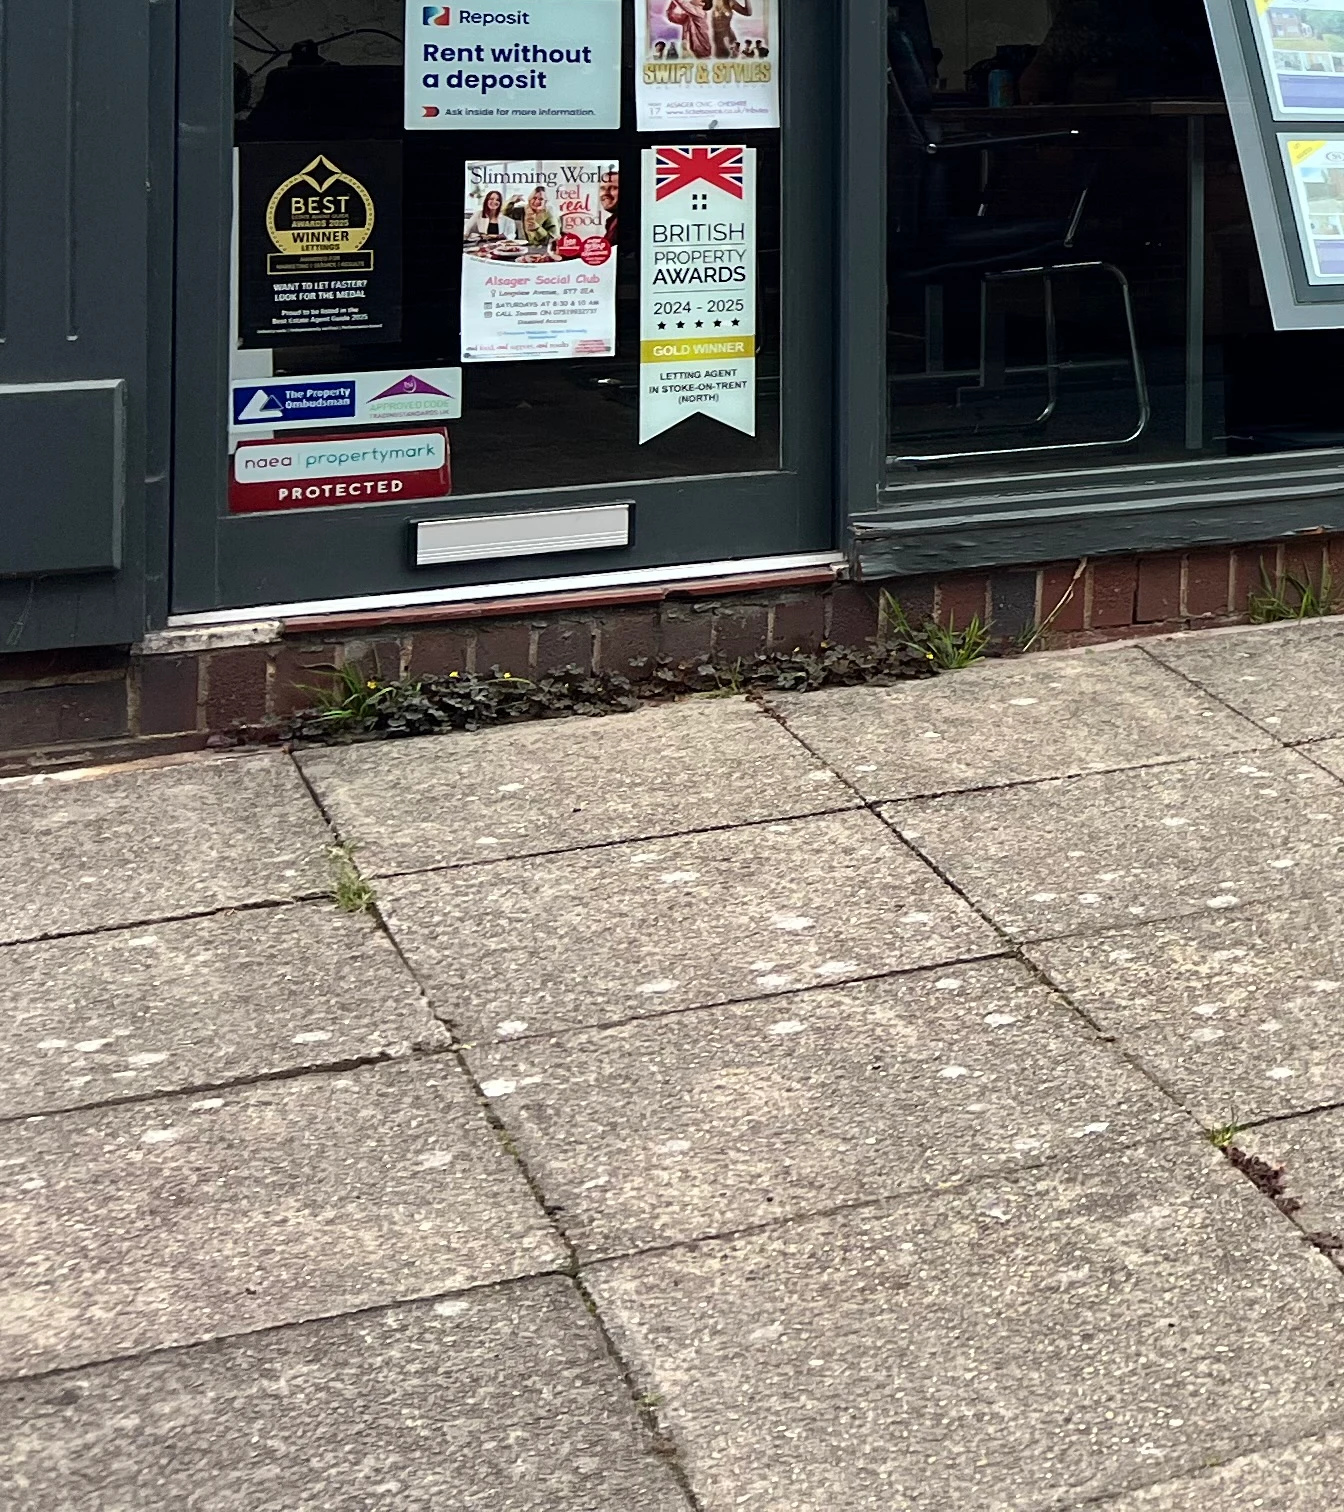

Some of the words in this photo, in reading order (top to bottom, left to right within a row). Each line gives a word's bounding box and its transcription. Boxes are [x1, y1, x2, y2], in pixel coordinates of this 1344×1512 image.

[459, 9, 530, 27] Reposit
[423, 43, 487, 63] Rent
[490, 42, 592, 65] without
[643, 62, 694, 85] SWIFT
[696, 62, 709, 84] &
[712, 62, 772, 85] STYLES
[422, 73, 440, 90] a
[446, 69, 547, 95] deposit
[444, 108, 463, 116] Ask
[465, 107, 494, 116] inside
[496, 107, 509, 116] for
[470, 165, 558, 187] Slimming
[560, 165, 613, 184] World
[555, 184, 580, 200] feel
[291, 196, 350, 214] BEST
[559, 194, 591, 212] real
[565, 210, 602, 229] good
[292, 230, 350, 243] WINNER
[653, 222, 745, 244] BRITISH
[654, 248, 747, 266] PROPERTY
[485, 276, 530, 288] Alsager
[535, 275, 570, 285] Social
[576, 274, 601, 284] Club
[652, 265, 747, 286] AWARDS
[273, 282, 299, 291] WANT
[301, 282, 313, 290] TO
[314, 281, 329, 290] LET
[331, 280, 368, 288] FASTER?
[274, 293, 297, 301] LOOK
[299, 292, 316, 300] FOR
[318, 291, 335, 299] THE
[336, 290, 366, 298] MEDAL
[653, 301, 692, 315] 2024
[707, 299, 744, 313] 2025
[653, 344, 691, 357] GOLD
[693, 342, 745, 355] WINNER
[660, 370, 702, 381] LETTING
[704, 368, 737, 378] AGENT
[285, 390, 304, 399] The
[306, 388, 351, 399] Property
[649, 385, 659, 394] IN
[661, 381, 747, 393] STOKE-ON-TRENT
[285, 398, 351, 409] Ombudsman
[369, 401, 421, 412] APPROVED
[423, 399, 450, 409] CODE
[678, 393, 719, 405] (NORTH)
[245, 455, 293, 470] naea
[305, 443, 436, 469] propertymark
[278, 480, 404, 501] PROTECTED
